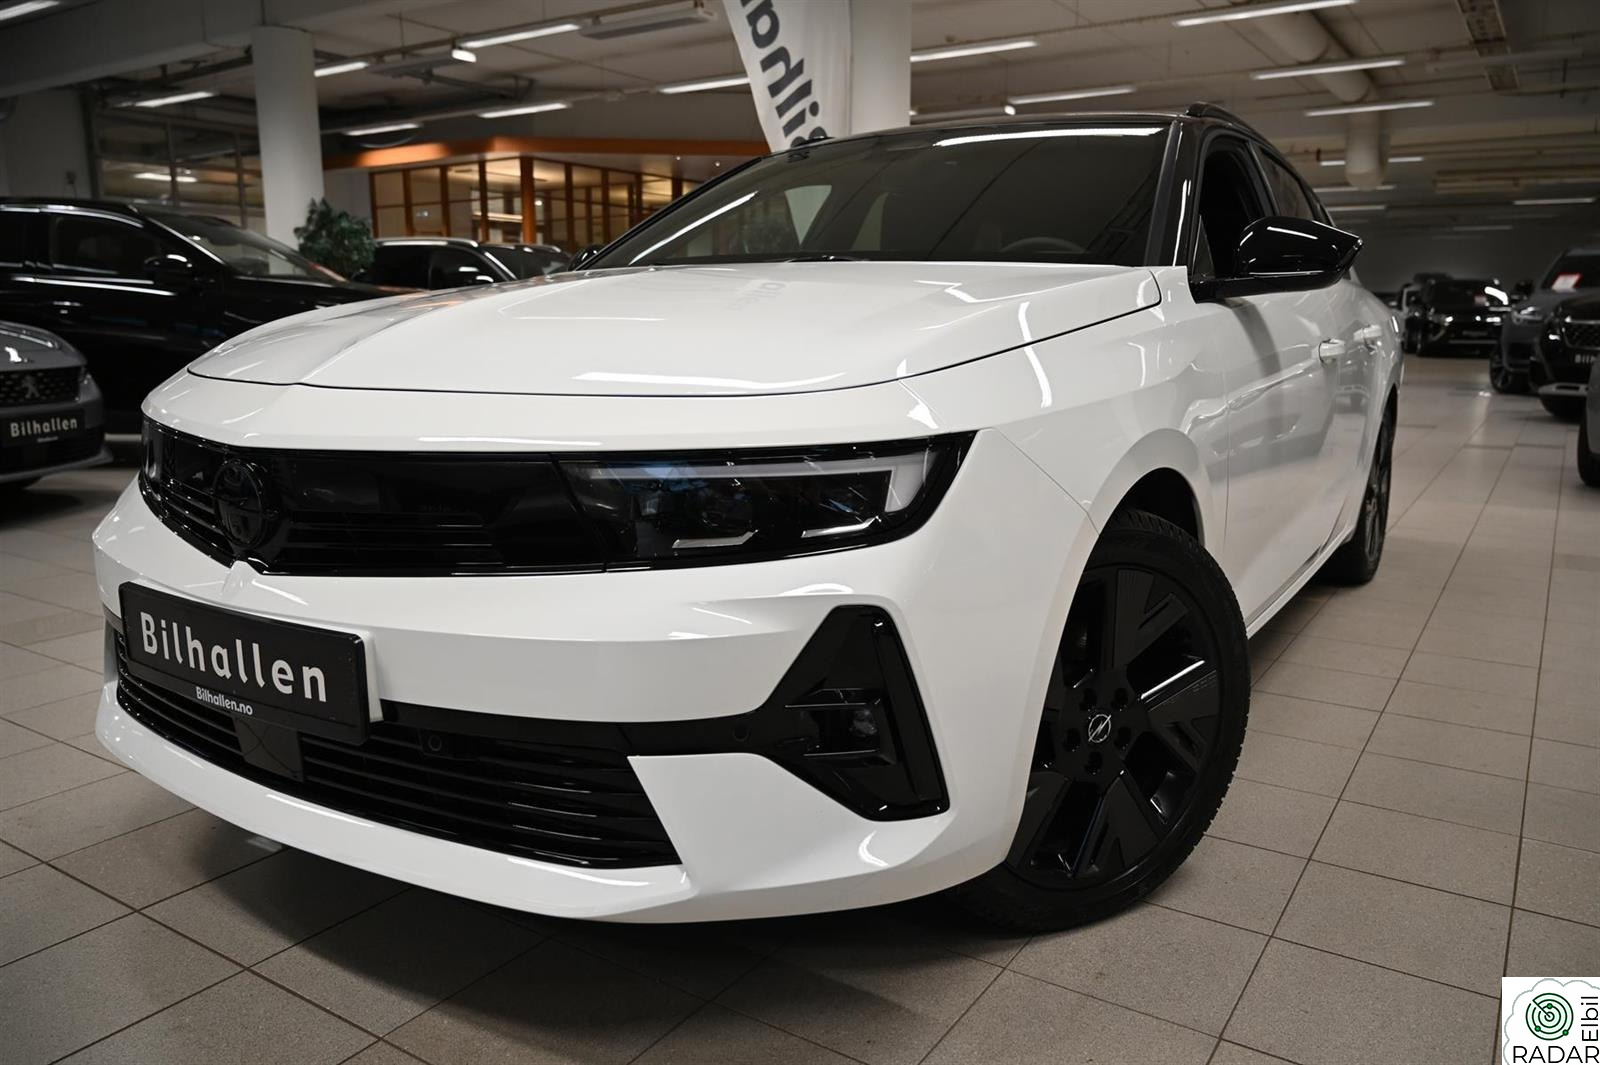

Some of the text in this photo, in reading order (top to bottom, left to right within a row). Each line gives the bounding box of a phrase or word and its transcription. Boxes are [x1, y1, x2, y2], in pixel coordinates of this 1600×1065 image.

[10, 417, 78, 438] Bilhallen
[138, 611, 328, 703] Bilhallen
[196, 686, 253, 716] Bilhallen.no
